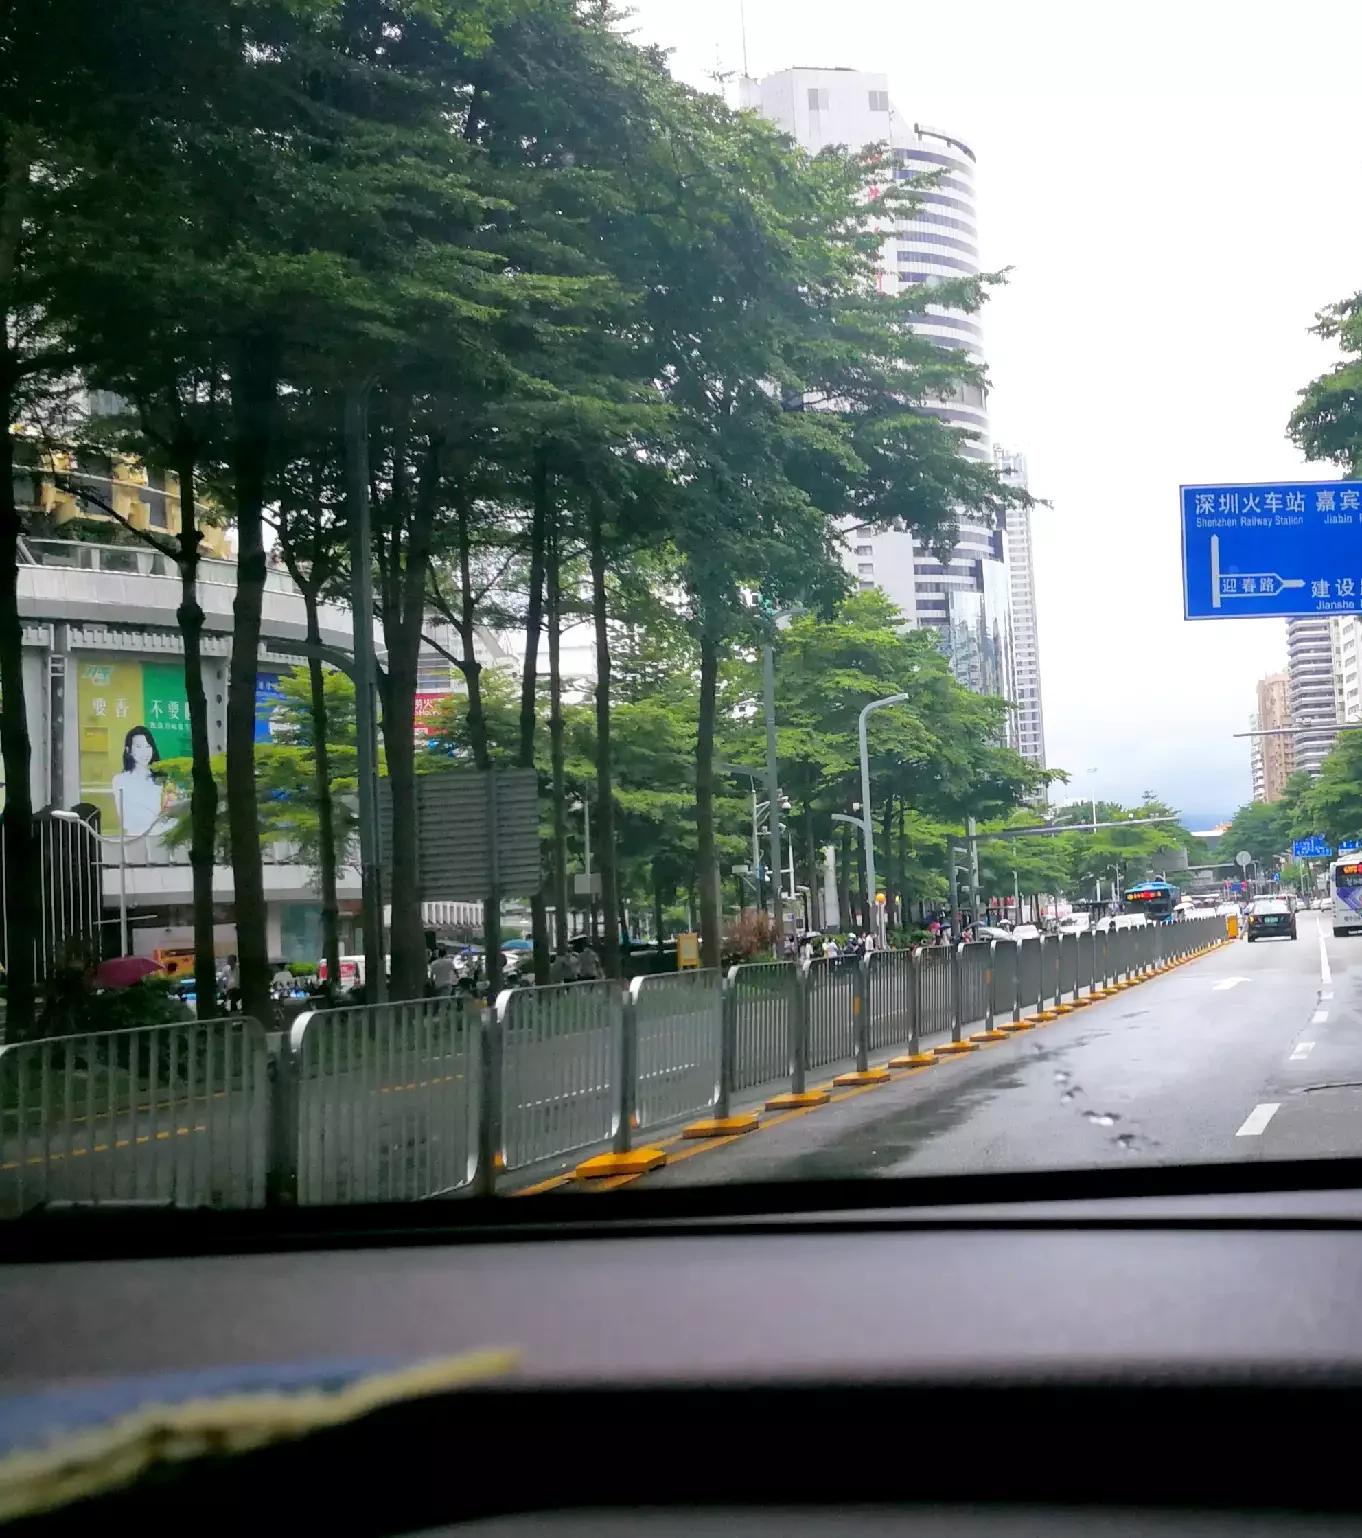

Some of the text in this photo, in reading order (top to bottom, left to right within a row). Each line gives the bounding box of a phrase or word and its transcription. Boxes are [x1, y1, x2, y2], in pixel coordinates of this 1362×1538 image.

[1195, 492, 1305, 515] 深圳火车站
[1196, 517, 1237, 528] Shenzhen
[1240, 516, 1272, 528] Railway
[1275, 515, 1304, 526] Station
[1222, 577, 1275, 593] 迎春路
